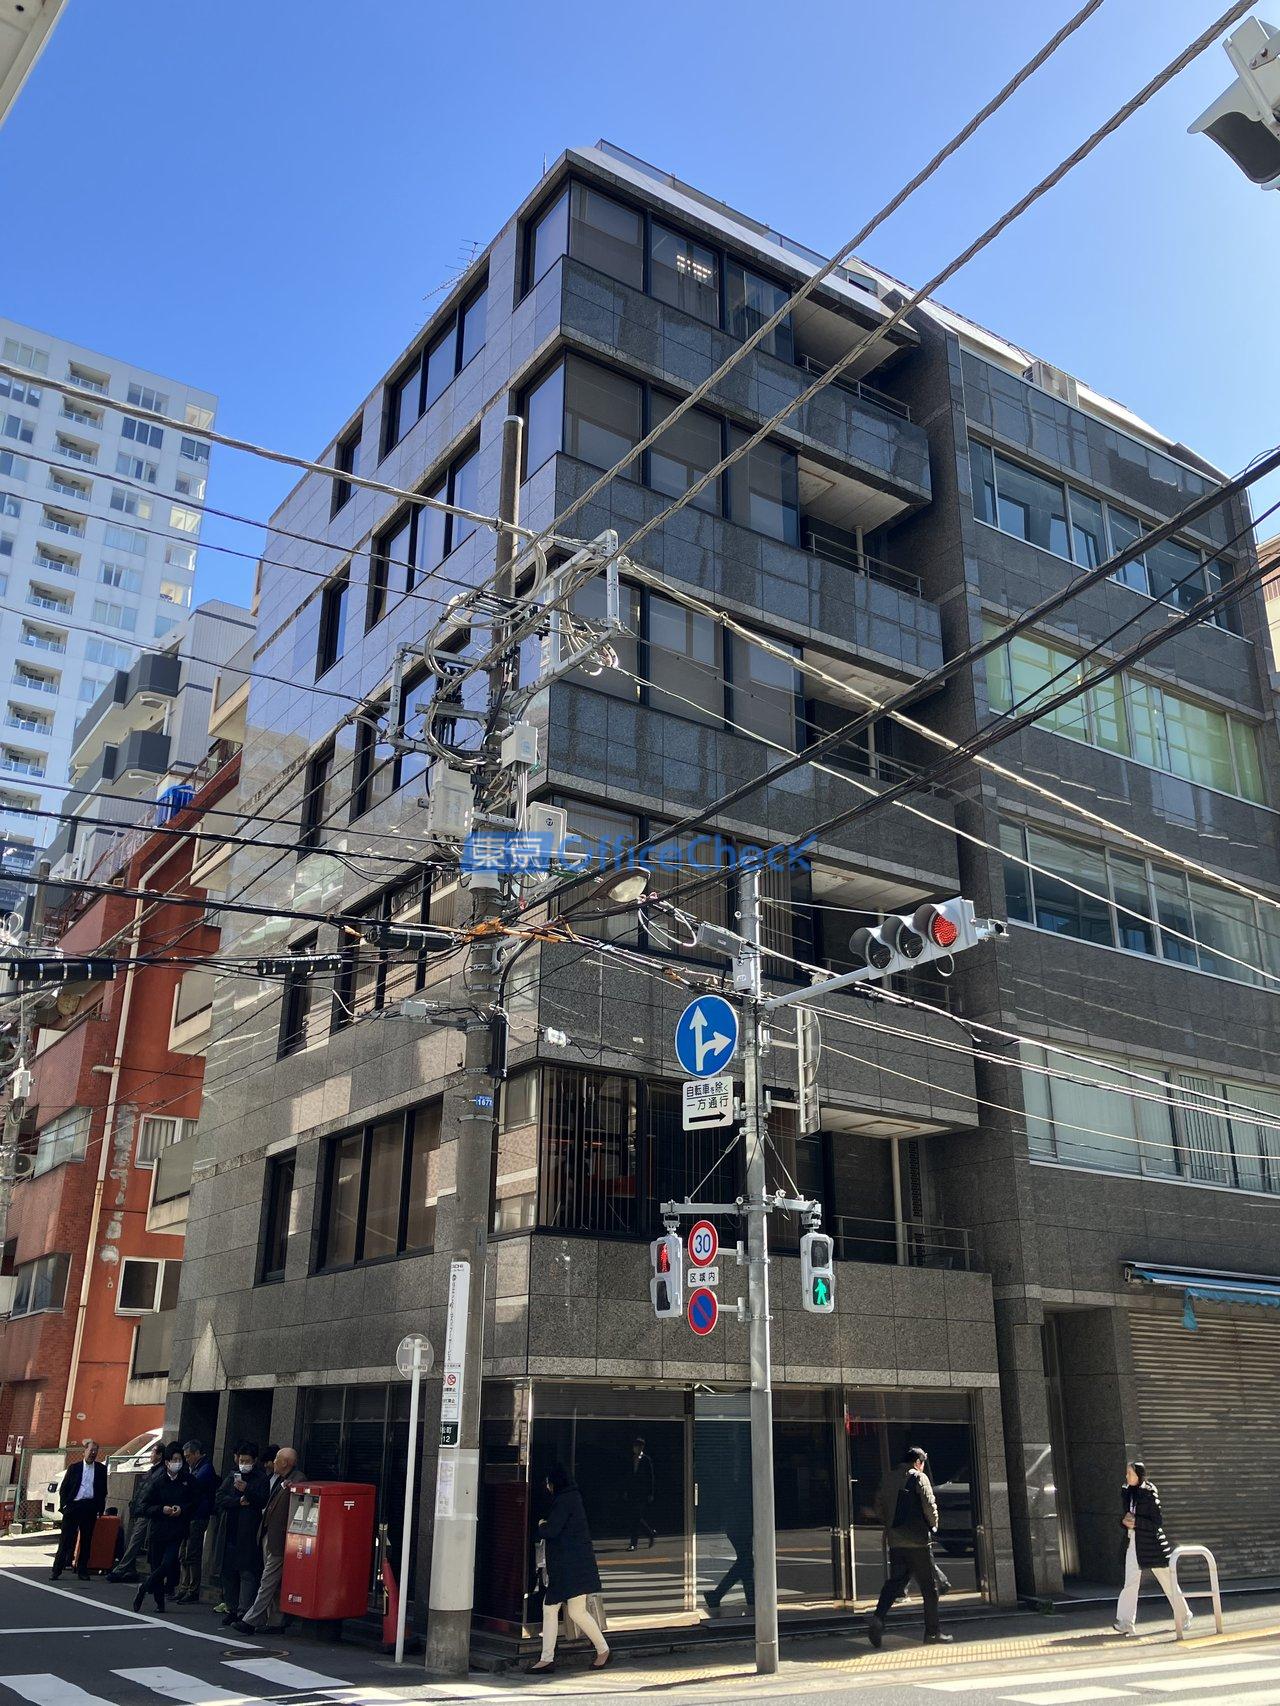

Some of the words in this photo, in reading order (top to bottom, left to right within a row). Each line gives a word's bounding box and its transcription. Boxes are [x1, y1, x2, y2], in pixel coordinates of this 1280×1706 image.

[686, 1081, 729, 1098] 自転車を除く
[686, 1096, 729, 1111] 一方通行
[694, 1233, 711, 1254] 30
[689, 1271, 716, 1283] 区域内
